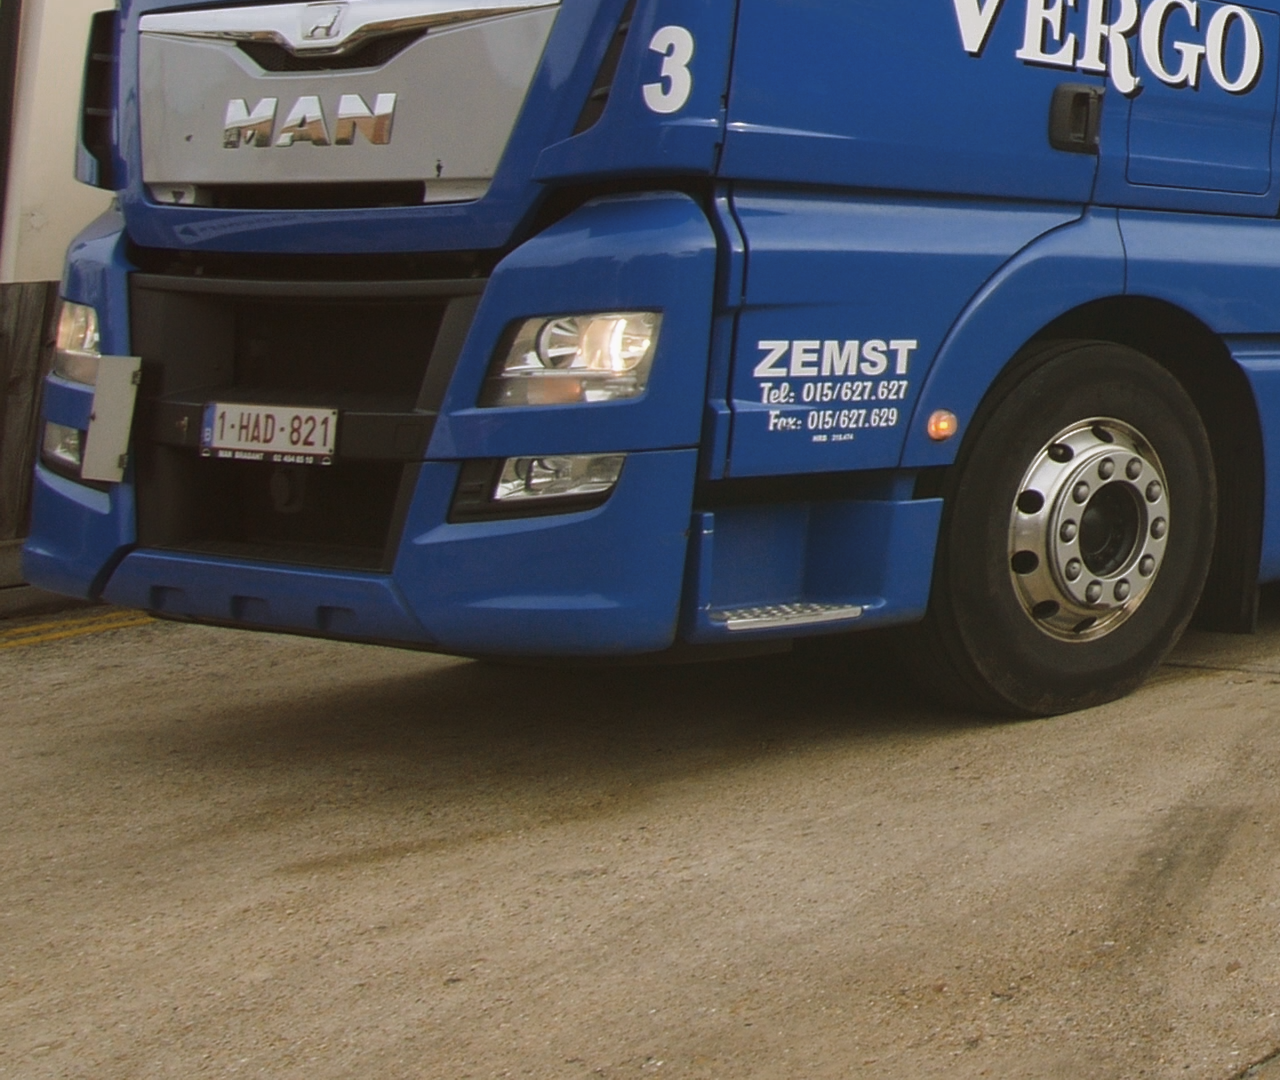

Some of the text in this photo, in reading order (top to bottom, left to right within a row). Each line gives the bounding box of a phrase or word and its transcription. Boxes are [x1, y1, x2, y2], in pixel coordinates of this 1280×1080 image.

[643, 25, 695, 114] 3
[223, 92, 397, 148] MAN
[753, 339, 918, 377] ZEMST
[760, 380, 908, 404] Tel: 015/627.627
[218, 410, 330, 447] 1-HAD-821
[769, 408, 898, 431] Fax: 015/627.629
